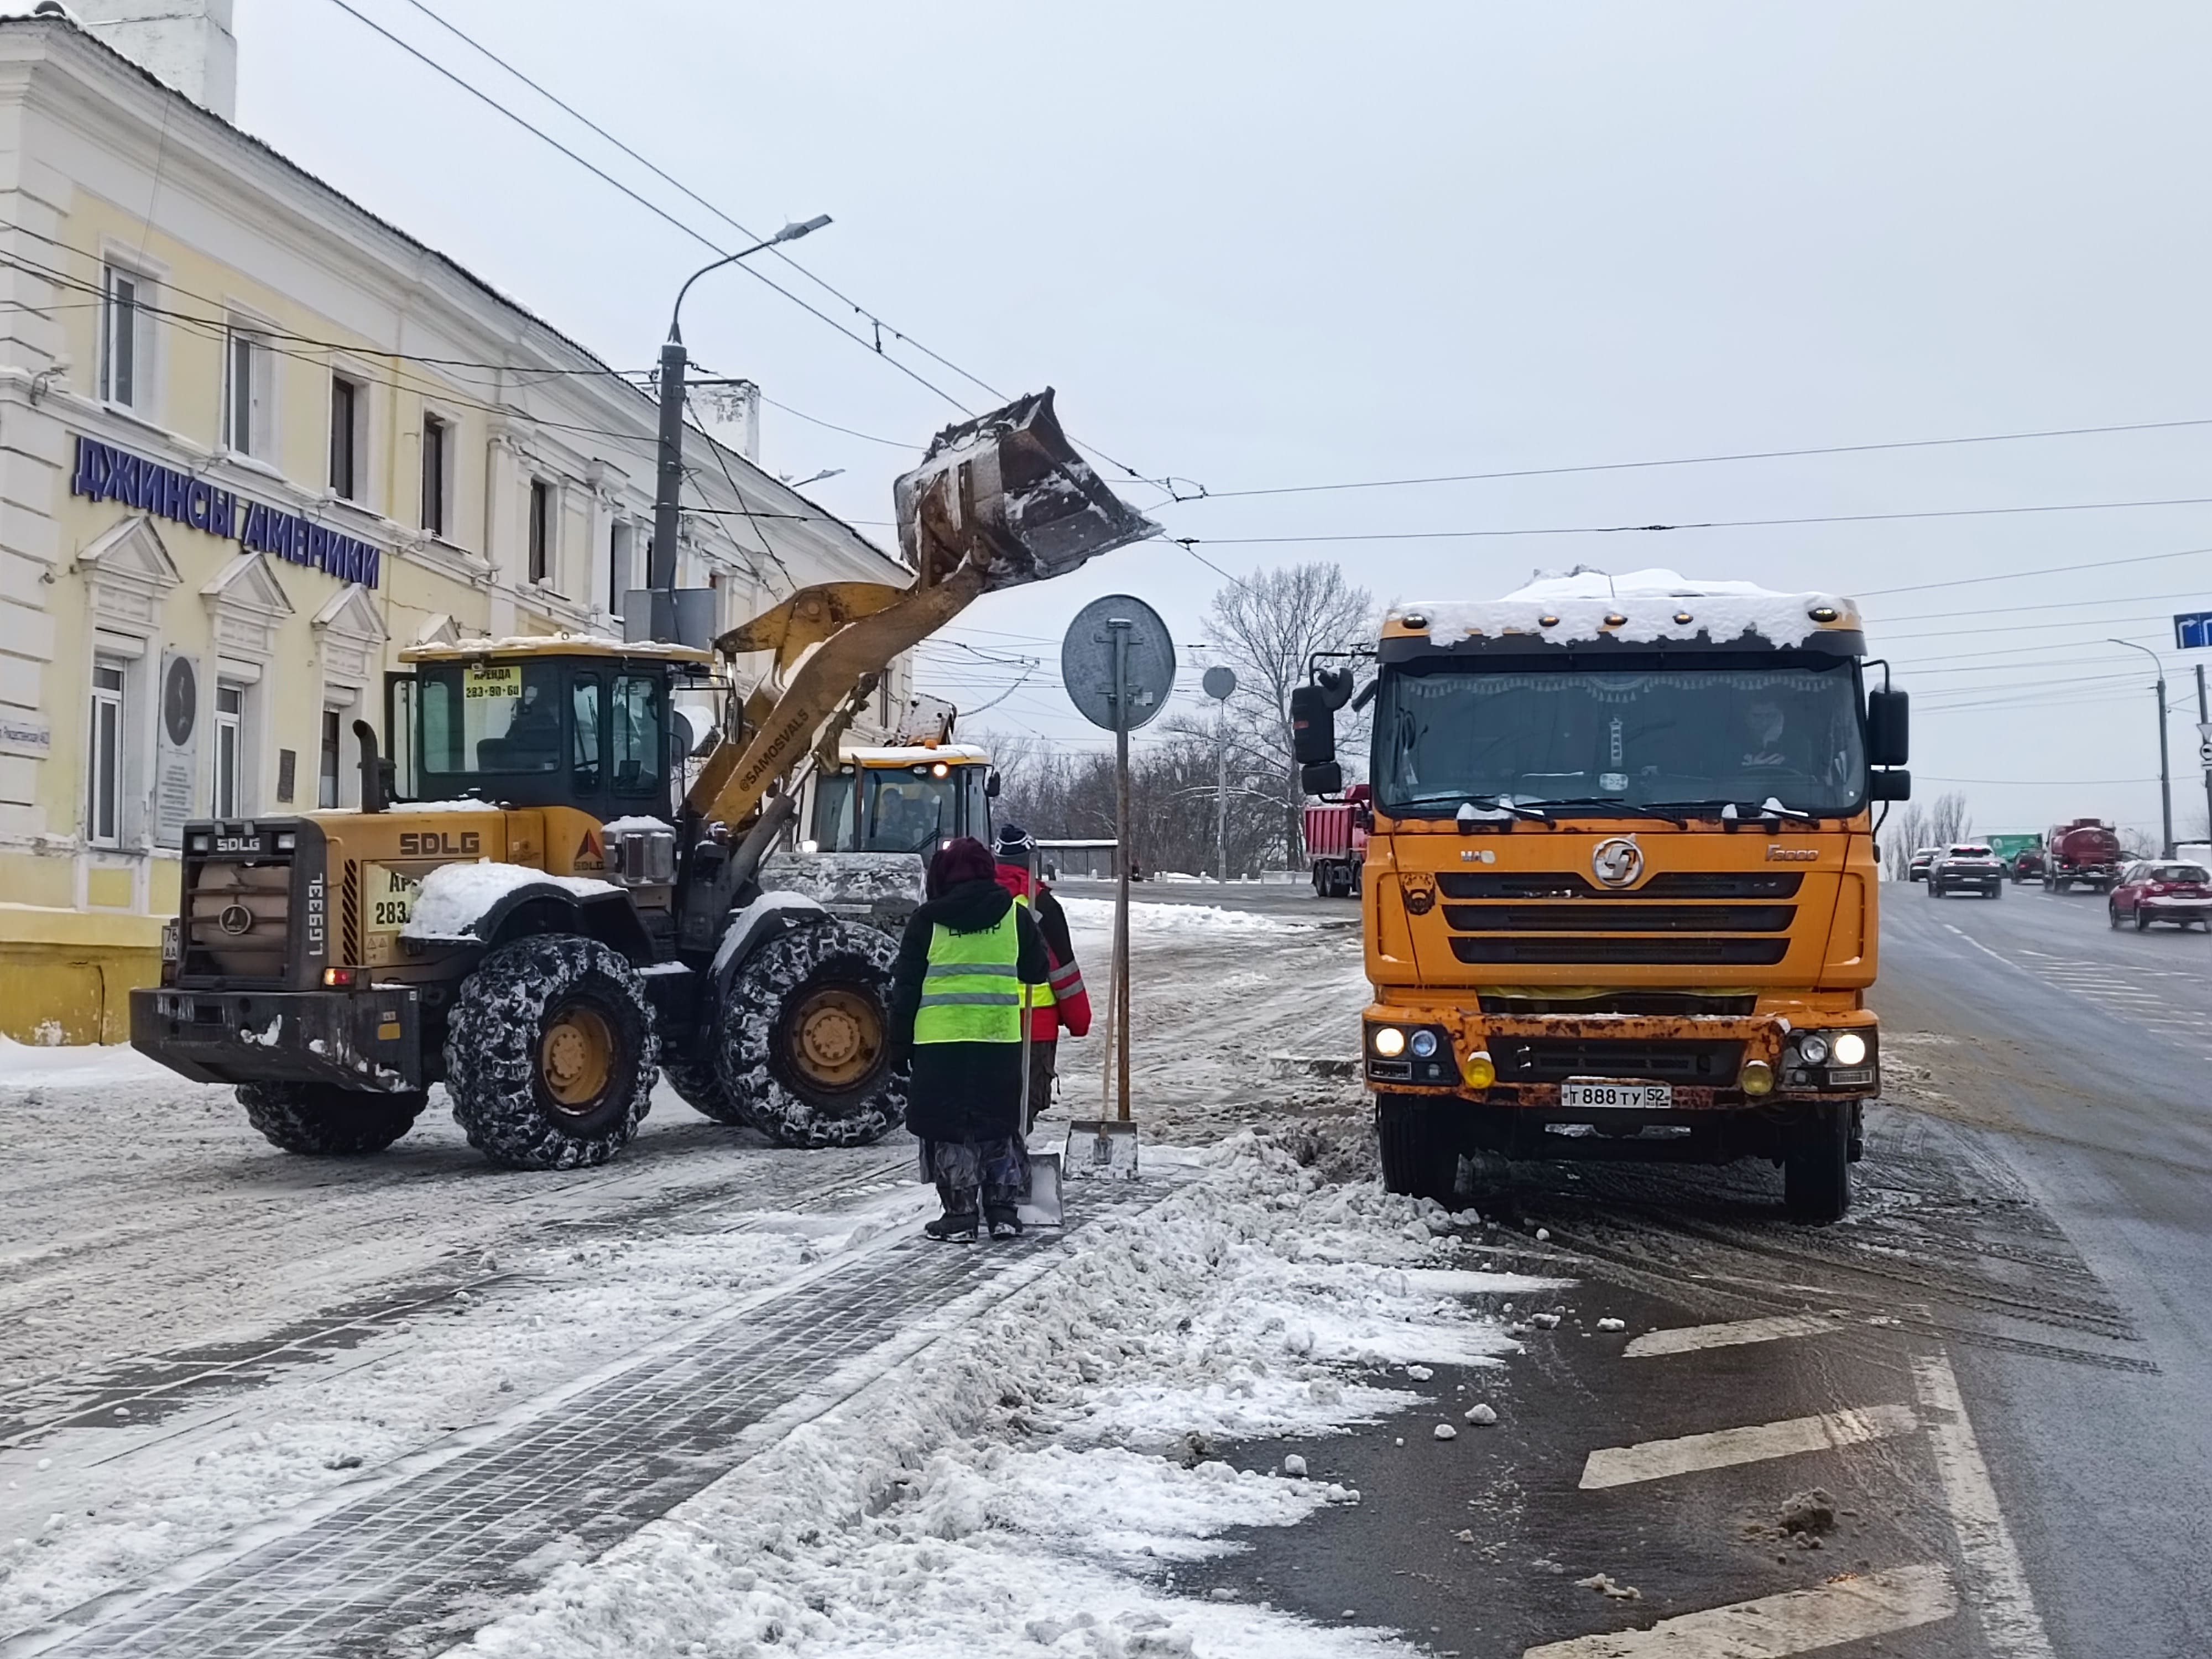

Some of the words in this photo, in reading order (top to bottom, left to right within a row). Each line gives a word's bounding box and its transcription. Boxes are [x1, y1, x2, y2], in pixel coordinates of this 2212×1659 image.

[73, 436, 239, 539] ДЖИНСЫ
[242, 502, 380, 589] АМЕРИКИ
[217, 837, 260, 851] SDLG
[400, 832, 479, 854] SDLG
[309, 872, 323, 955] LG933L
[1647, 1088, 1665, 1101] 52
